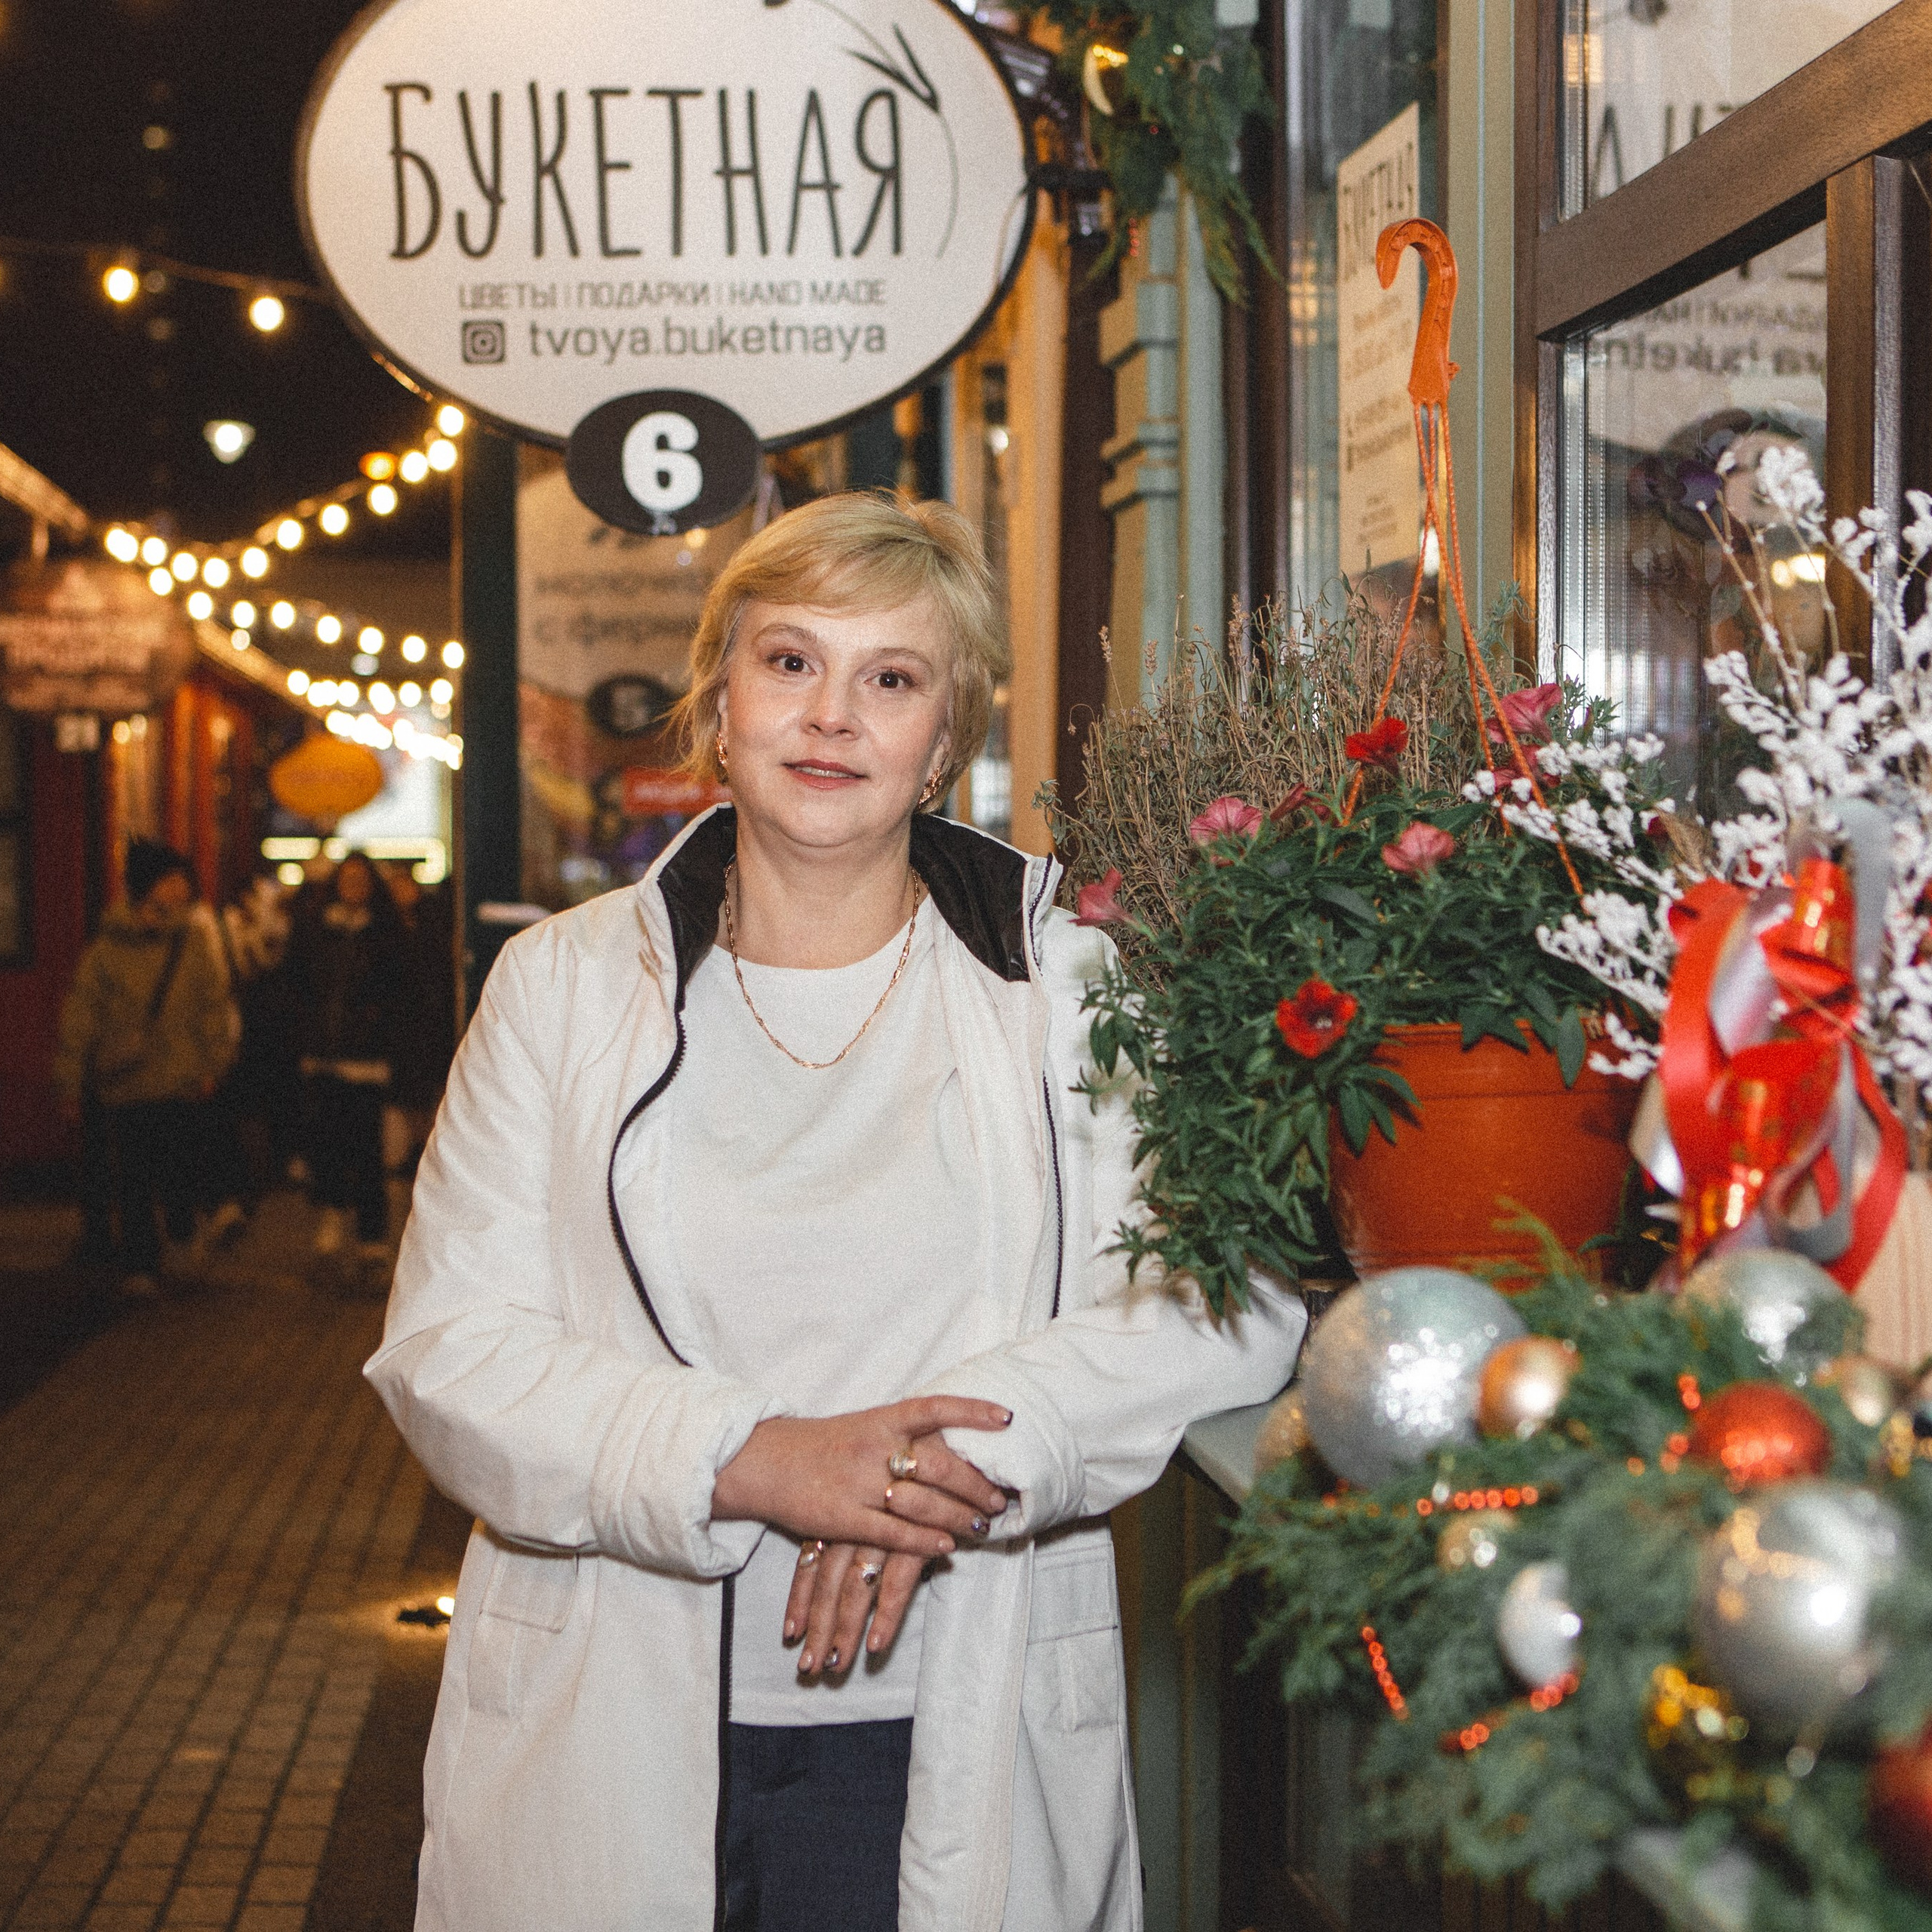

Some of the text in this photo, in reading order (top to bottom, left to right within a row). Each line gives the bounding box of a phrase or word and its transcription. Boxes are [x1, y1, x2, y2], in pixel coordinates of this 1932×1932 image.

[385, 81, 903, 260] БУКЕТНАЯ
[459, 278, 887, 311] ЦВЕТЫ ПОДАРКИ HAND MADE
[530, 315, 887, 366] tvoya.buketnaya
[622, 411, 703, 513] 6
